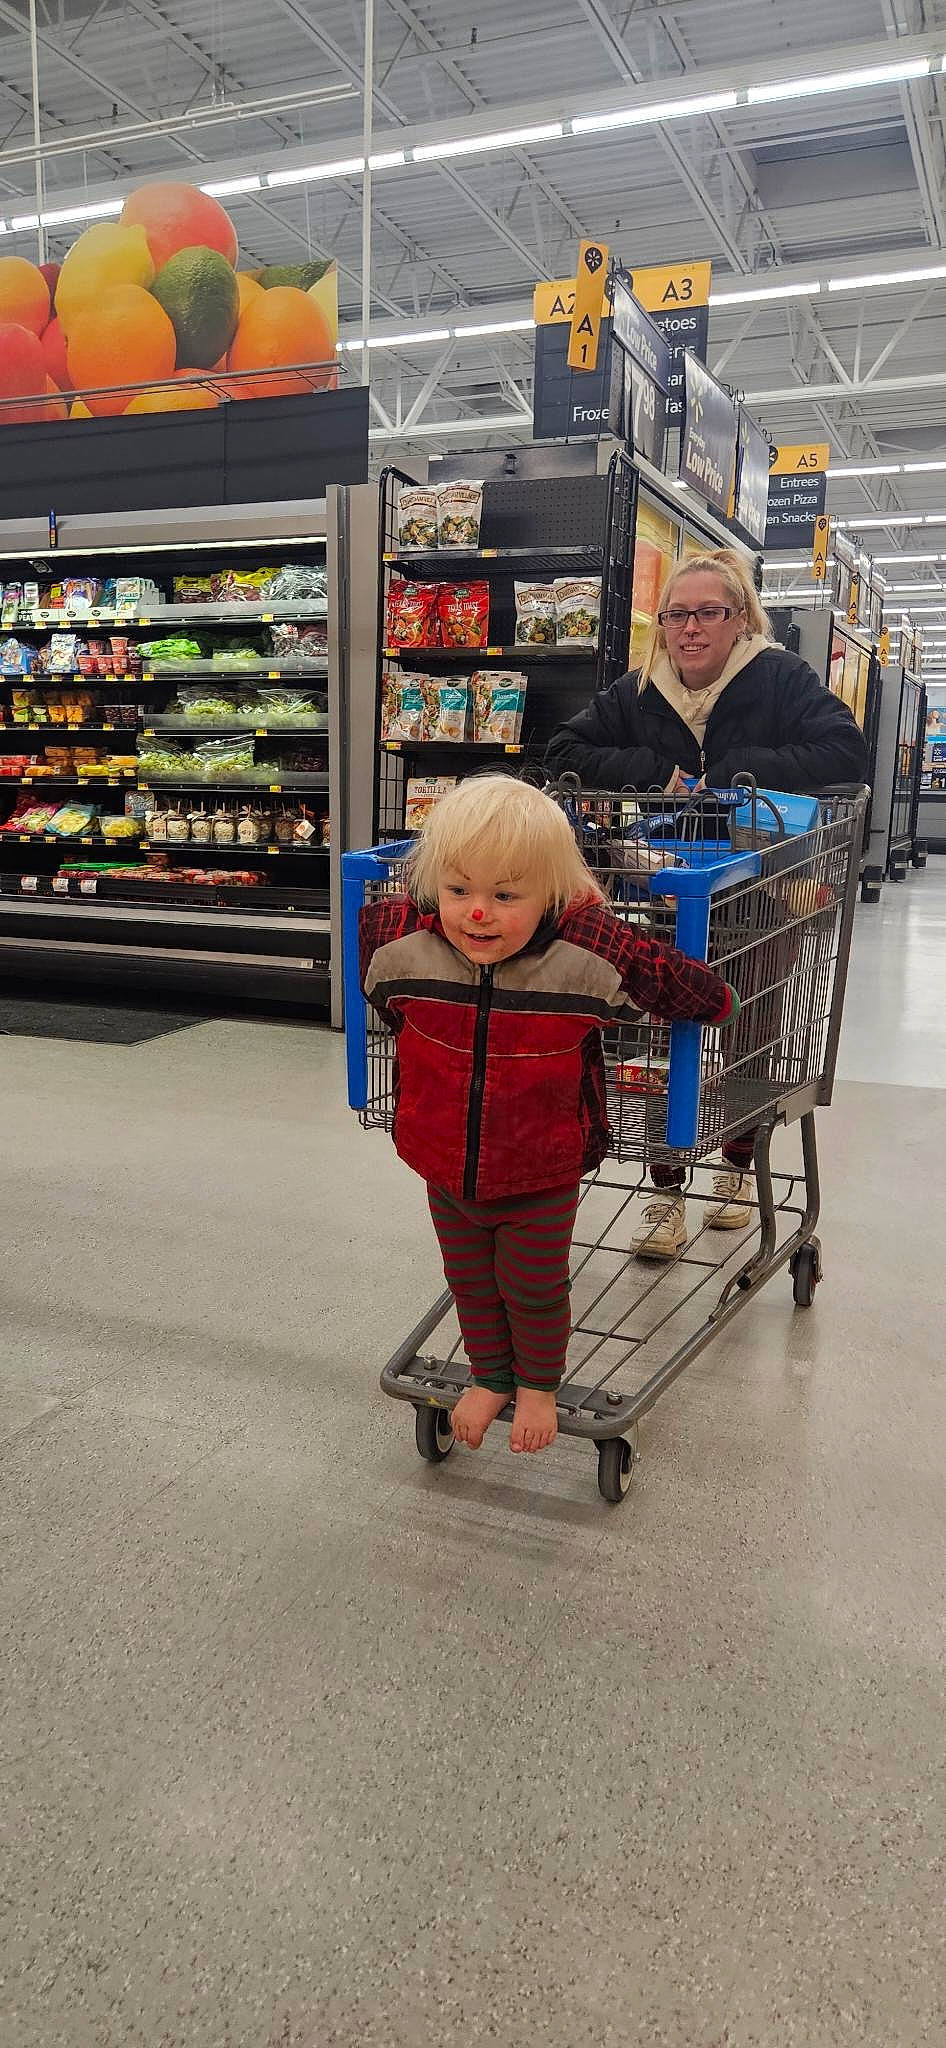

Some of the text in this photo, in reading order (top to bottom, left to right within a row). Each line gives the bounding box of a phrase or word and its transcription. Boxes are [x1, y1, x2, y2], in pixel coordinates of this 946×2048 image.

[662, 278, 693, 303] A3
[656, 316, 697, 333] atoes
[577, 314, 594, 363] A 1
[573, 405, 610, 422] Froze
[686, 441, 723, 495] Low Price
[797, 453, 818, 469] A5
[780, 477, 819, 489] Entrees
[768, 494, 818, 507] ozen Pizza
[782, 511, 817, 523] Snacks
[815, 566, 822, 577] 3
